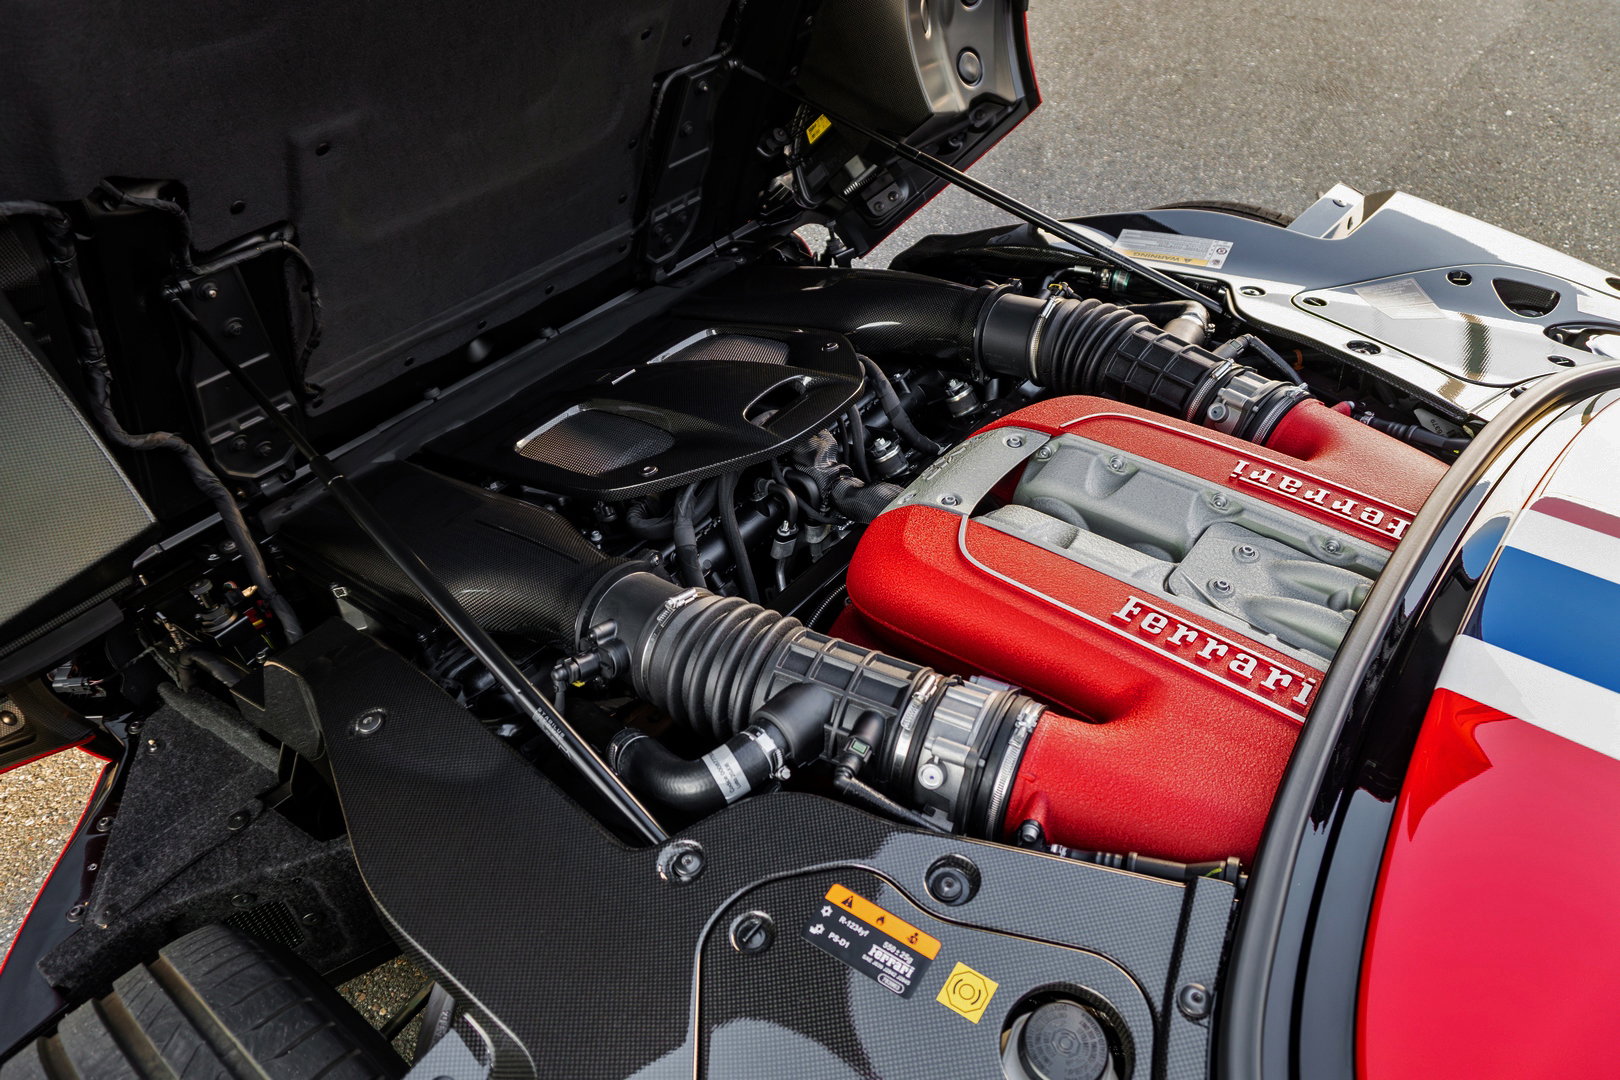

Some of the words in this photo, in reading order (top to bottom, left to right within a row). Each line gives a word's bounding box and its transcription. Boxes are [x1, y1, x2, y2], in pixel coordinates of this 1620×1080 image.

[1133, 252, 1180, 263] WARNING
[1230, 459, 1411, 540] Ferrari
[1112, 595, 1317, 707] Ferrari
[537, 707, 565, 738] STABILUS
[838, 916, 870, 937] R-1234yf
[867, 944, 916, 978] Ferrari
